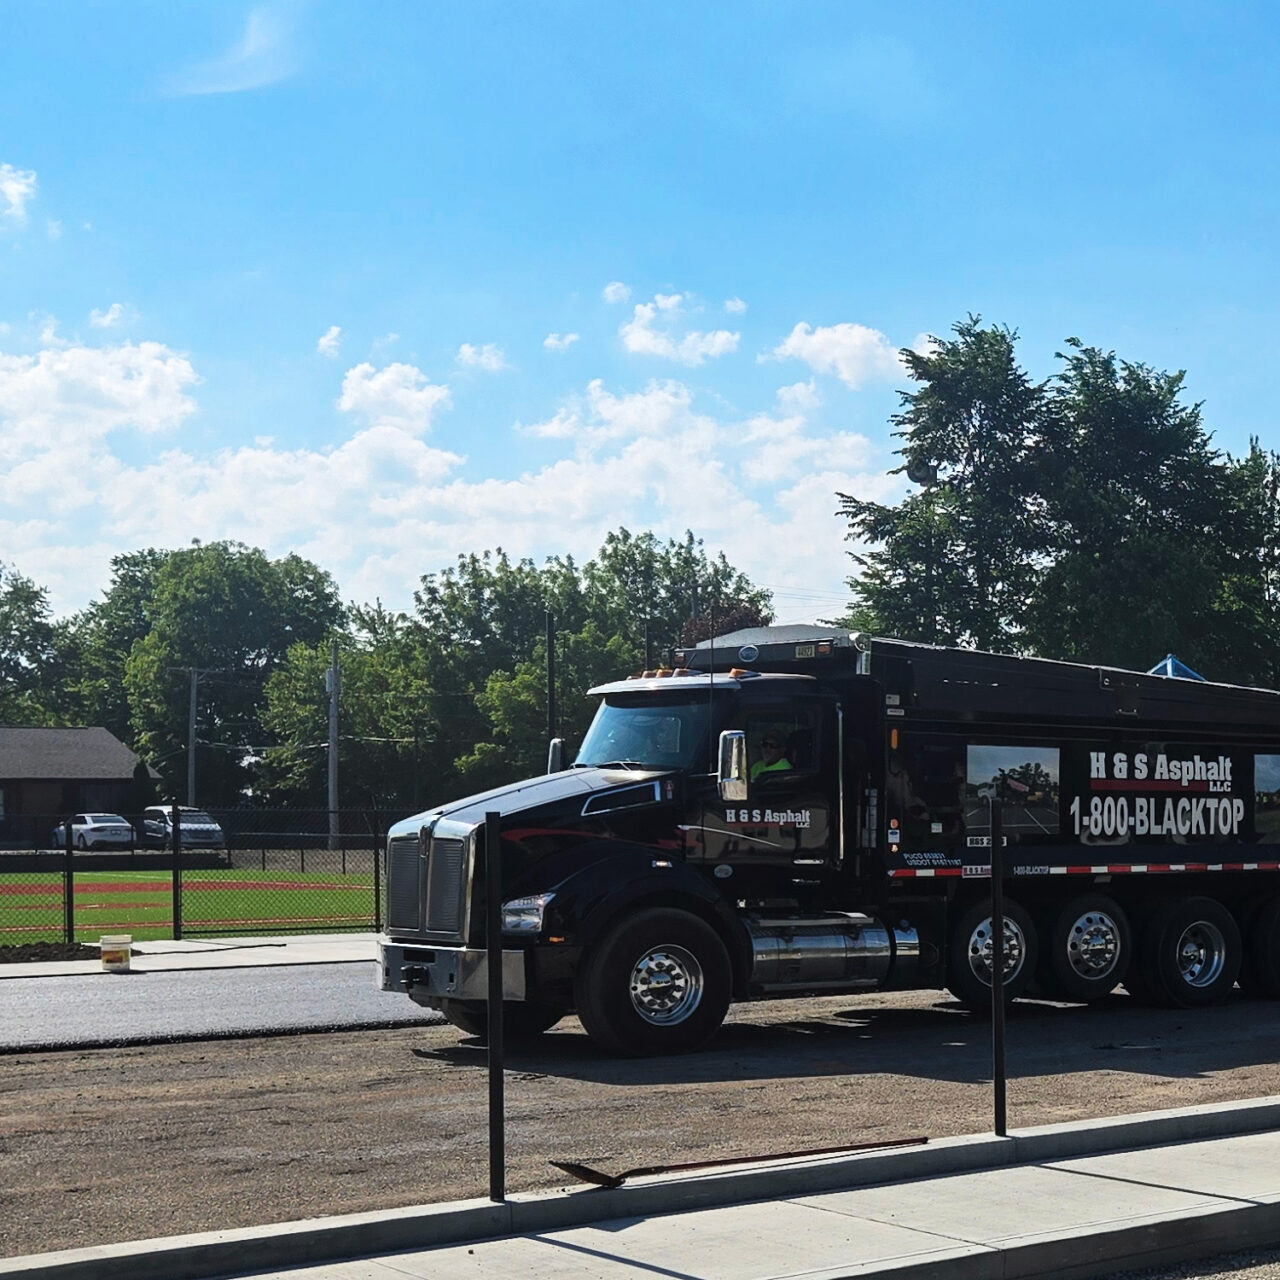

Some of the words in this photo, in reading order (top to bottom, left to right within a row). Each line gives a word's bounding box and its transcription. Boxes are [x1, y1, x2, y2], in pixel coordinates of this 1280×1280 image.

[1090, 751, 1106, 779] H
[1113, 752, 1128, 779] &
[1134, 753, 1148, 780] S
[1154, 754, 1232, 786] Asphalt
[1209, 781, 1231, 792] LLC
[726, 809, 736, 822] H
[739, 809, 749, 822] &
[752, 809, 761, 822] S
[764, 809, 811, 825] Asphalt
[1070, 796, 1245, 836] 1-800-BLACKTOP
